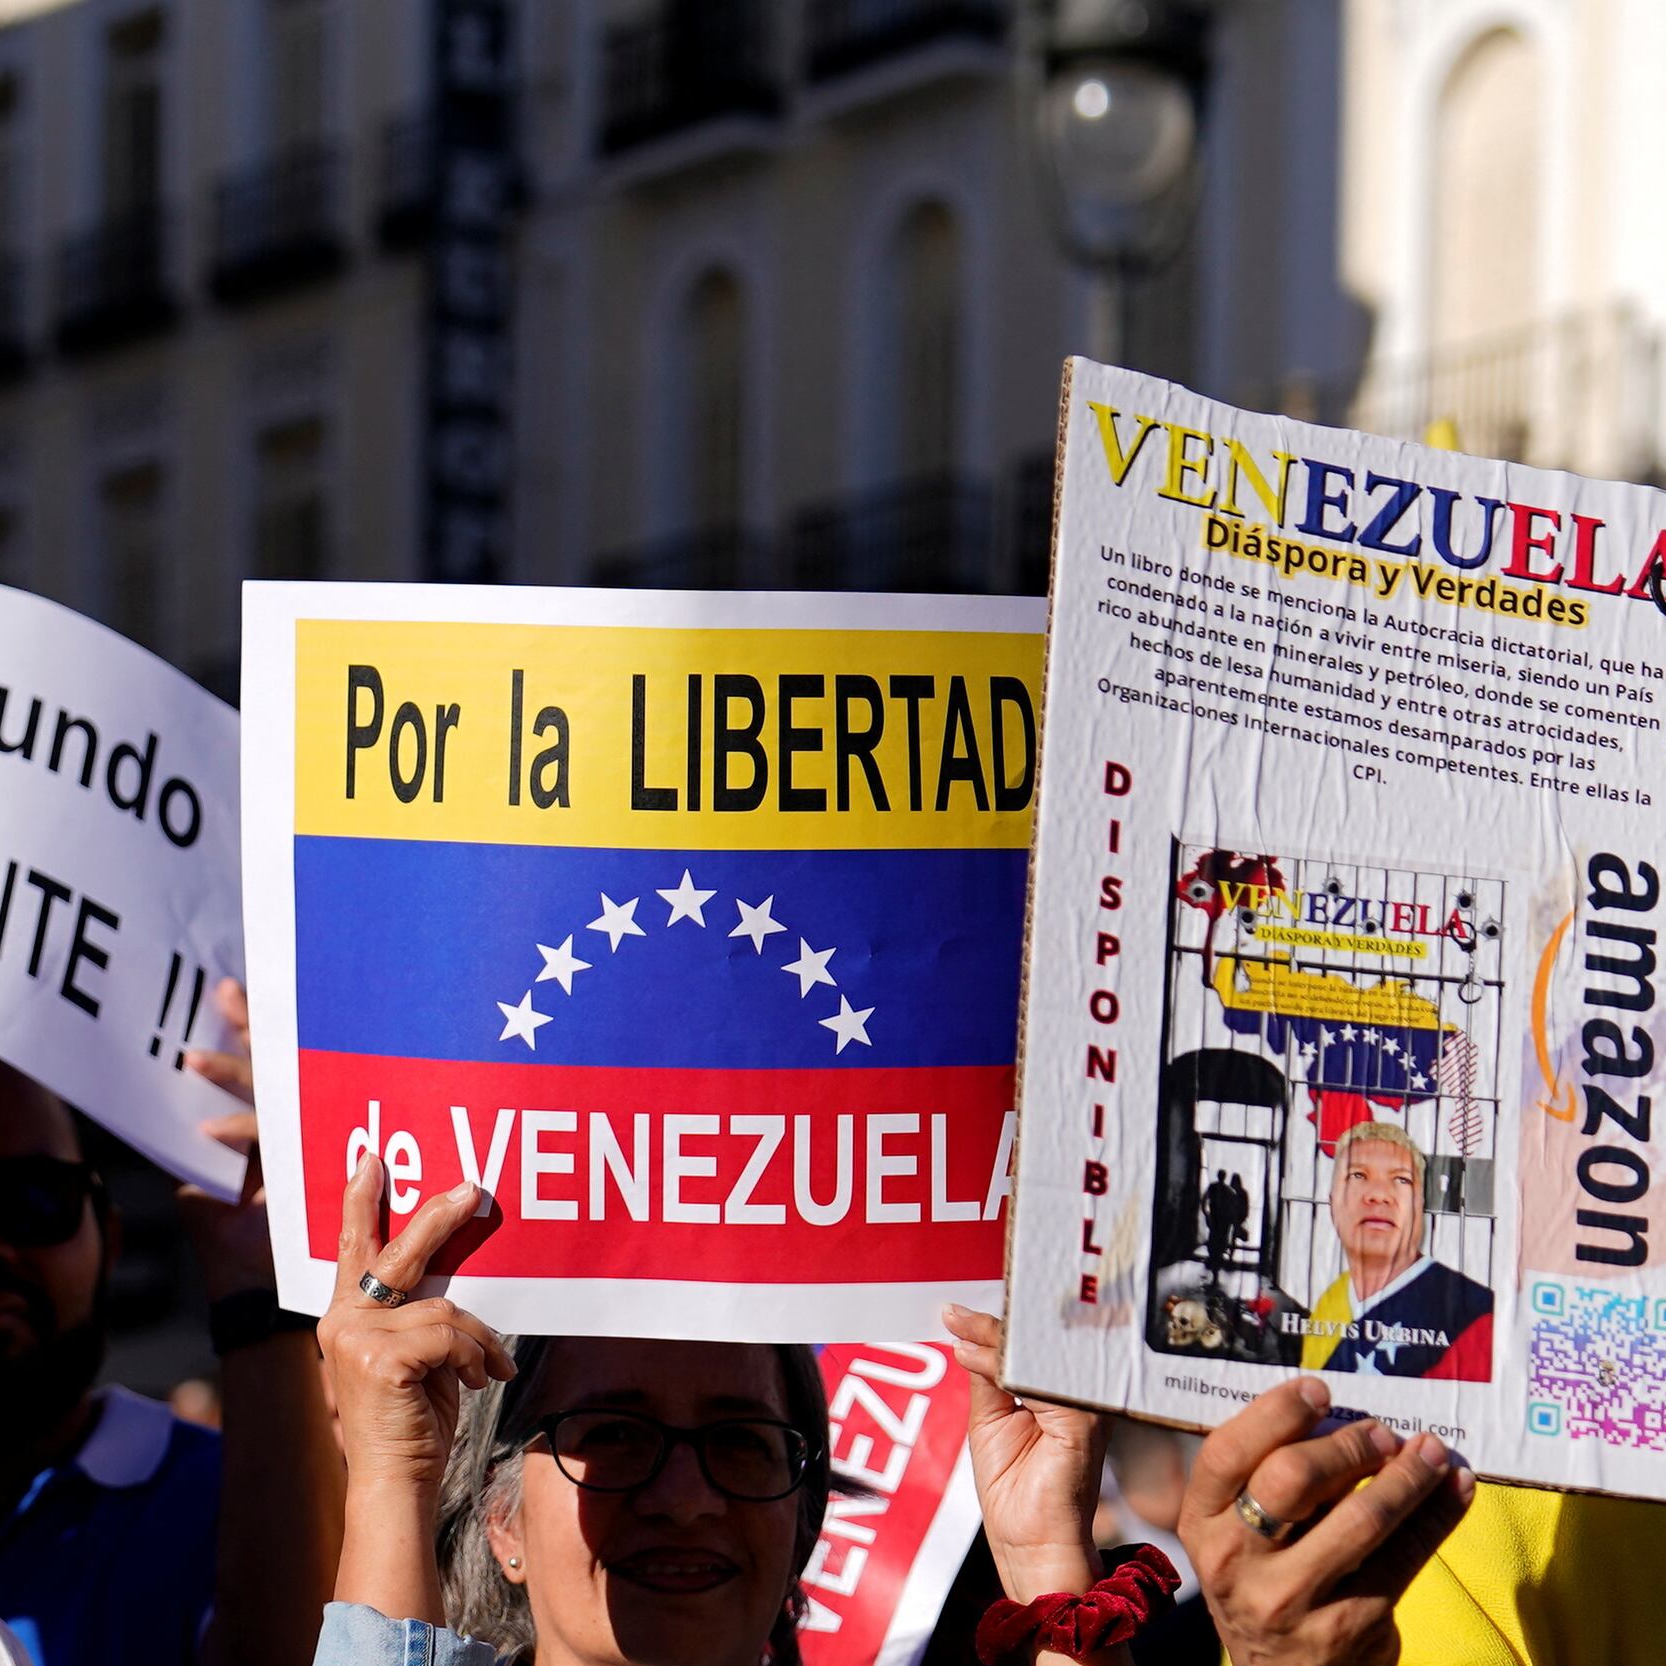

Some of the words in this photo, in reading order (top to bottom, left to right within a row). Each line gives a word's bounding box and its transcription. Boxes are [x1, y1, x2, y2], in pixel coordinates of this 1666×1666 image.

[1101, 546, 1125, 565] Un
[1132, 552, 1173, 576] libro
[1180, 563, 1235, 592] donde
[1241, 585, 1261, 600] se
[1268, 592, 1356, 621] menciona
[1365, 608, 1377, 626] la
[1385, 614, 1485, 648] Autocracia
[1491, 635, 1593, 672] dictatorial,
[1601, 660, 1634, 677] que
[1642, 662, 1663, 680] ha
[1205, 515, 1368, 583] Diáspora
[1378, 563, 1401, 597] y
[1412, 563, 1586, 626] Verdades
[1099, 599, 1131, 619] rico
[1137, 611, 1237, 646] abundante
[1244, 638, 1265, 652] en
[1274, 643, 1363, 675] minerales
[1369, 667, 1379, 684] y
[1385, 671, 1470, 700] petróleo,
[1475, 683, 1534, 709] donde
[1539, 700, 1560, 714] se
[1565, 705, 1661, 731] comenten
[1107, 579, 1209, 613] condenado
[1214, 606, 1224, 618] a
[1231, 604, 1245, 622] la
[1253, 614, 1313, 637] nación
[1320, 629, 1329, 641] a
[1335, 629, 1375, 651] vivir
[1381, 643, 1431, 662] entre
[1437, 653, 1512, 683] miseria,
[1518, 668, 1579, 691] siendo
[1586, 682, 1609, 696] un
[1617, 683, 1654, 704] País
[1131, 632, 1194, 663] hechos
[1201, 651, 1222, 670] de
[1227, 657, 1263, 679] lesa
[1270, 666, 1375, 704] humanidad
[1381, 696, 1392, 713] y
[1397, 700, 1447, 720] entre
[1453, 710, 1501, 730] otras
[1507, 720, 1624, 755] atrocidades,
[346, 664, 460, 804] Por
[507, 668, 572, 809] la
[631, 672, 1035, 815] LIBERTAD
[1099, 677, 1237, 725] Organizaciones
[1245, 712, 1389, 759] Internacionales
[1396, 752, 1523, 785] competentes.
[1531, 772, 1579, 794] Entre
[1586, 782, 1628, 803] ellas
[1636, 789, 1652, 807] la
[1155, 669, 1299, 714] aparentemente
[1305, 707, 1383, 732] estamos
[1389, 719, 1527, 760] desamparados
[1533, 750, 1563, 767] por
[1570, 752, 1595, 773] las
[1353, 764, 1387, 787] CPI.
[1217, 879, 1468, 939] VENEZUELA
[1574, 850, 1661, 1268] amazon
[346, 1100, 424, 1215] de
